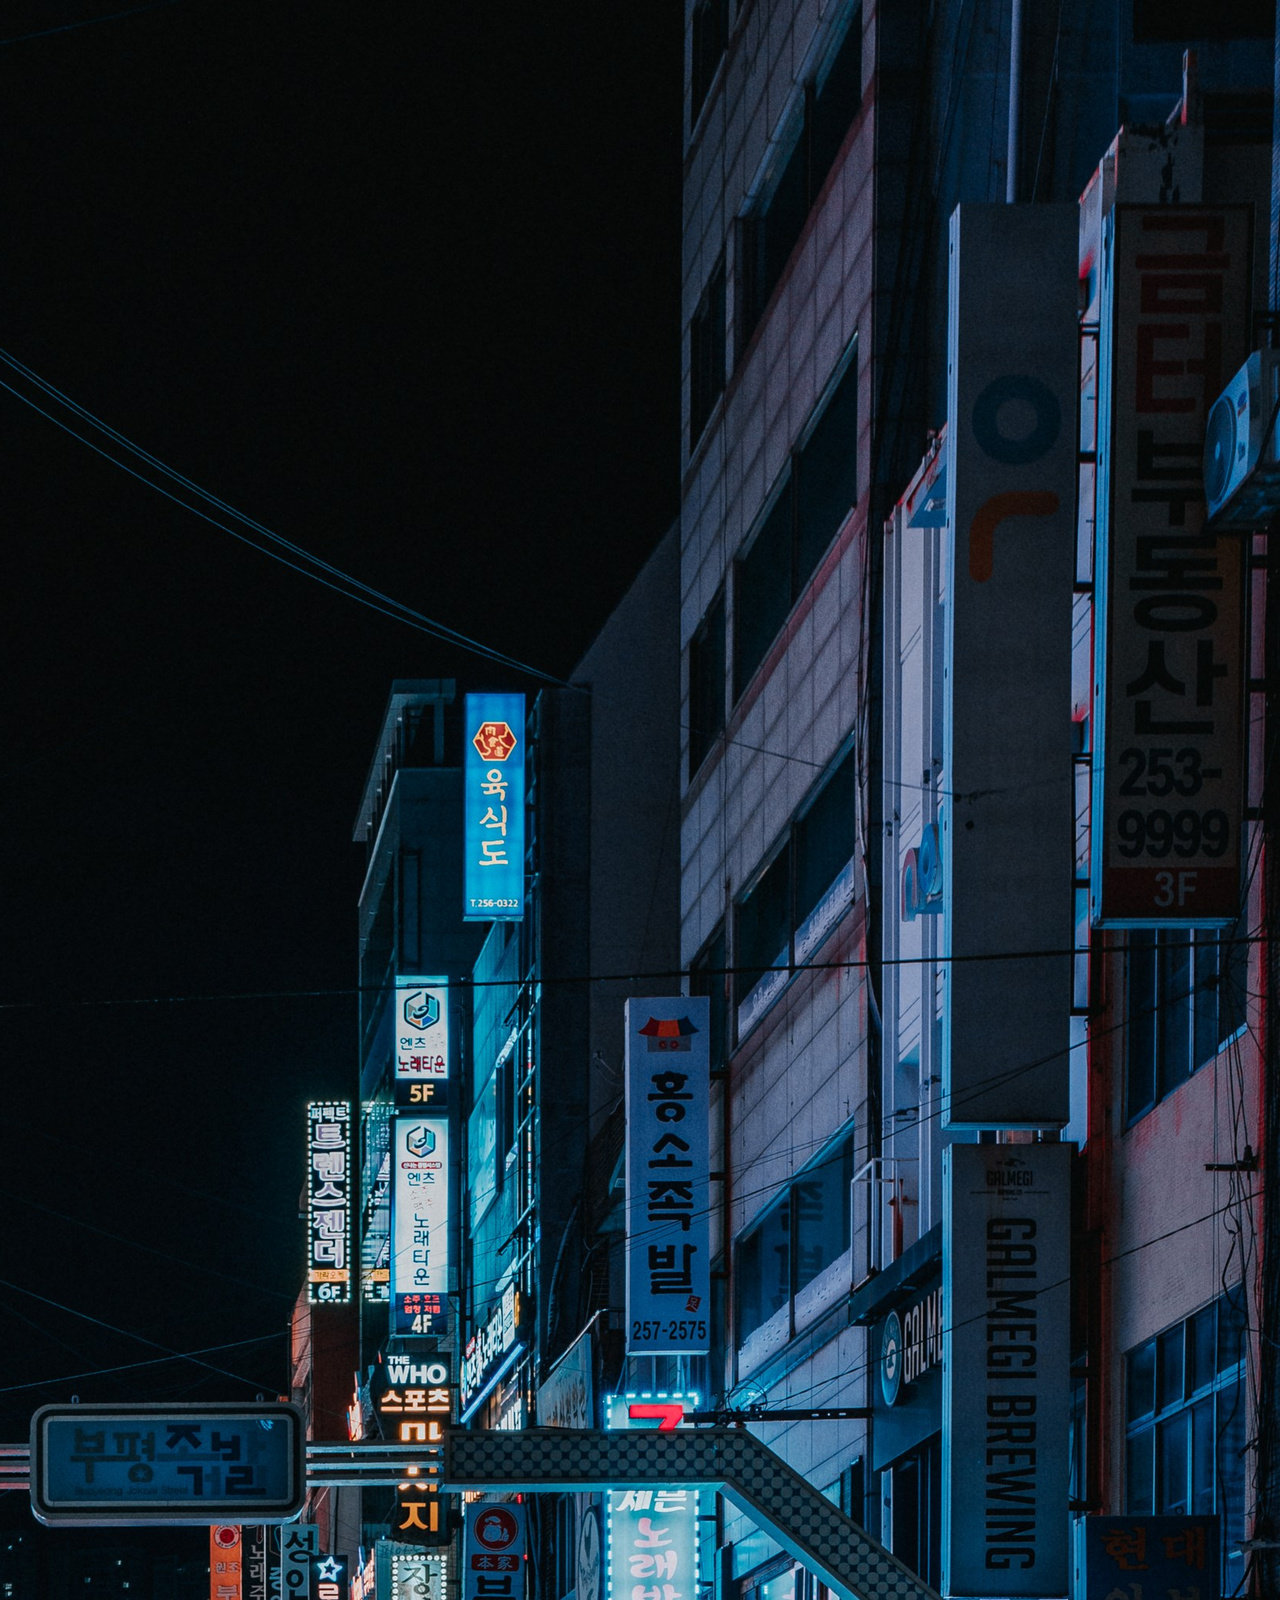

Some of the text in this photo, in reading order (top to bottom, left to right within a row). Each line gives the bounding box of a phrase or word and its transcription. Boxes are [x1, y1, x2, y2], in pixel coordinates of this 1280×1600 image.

[1120, 748, 1223, 797] 253-
[479, 768, 508, 867] 육식도
[1118, 810, 1230, 859] 9999
[1152, 871, 1198, 907] 3F
[470, 898, 519, 909] T.256-0322
[397, 1054, 446, 1073] 노래타운
[409, 1084, 435, 1101] 5F
[312, 1106, 348, 1122] 퍼펙트
[407, 1172, 435, 1186] 엔츠
[647, 1071, 697, 1295] 홍소족발
[986, 1170, 1033, 1186] GALMEGI
[312, 1123, 347, 1269] 트렌스젠더
[413, 1213, 430, 1287] 노래타운
[318, 1283, 341, 1299] 6F
[986, 1218, 1037, 1383] GALMEGI
[411, 1314, 432, 1333] 4F
[632, 1320, 707, 1341] 257-2575
[388, 1356, 410, 1365] THE
[388, 1365, 447, 1384] WHO
[380, 1388, 450, 1412] 스포츠
[986, 1397, 1037, 1570] BREWING
[1101, 1525, 1208, 1571] 현대
[477, 1555, 514, 1570] 本家
